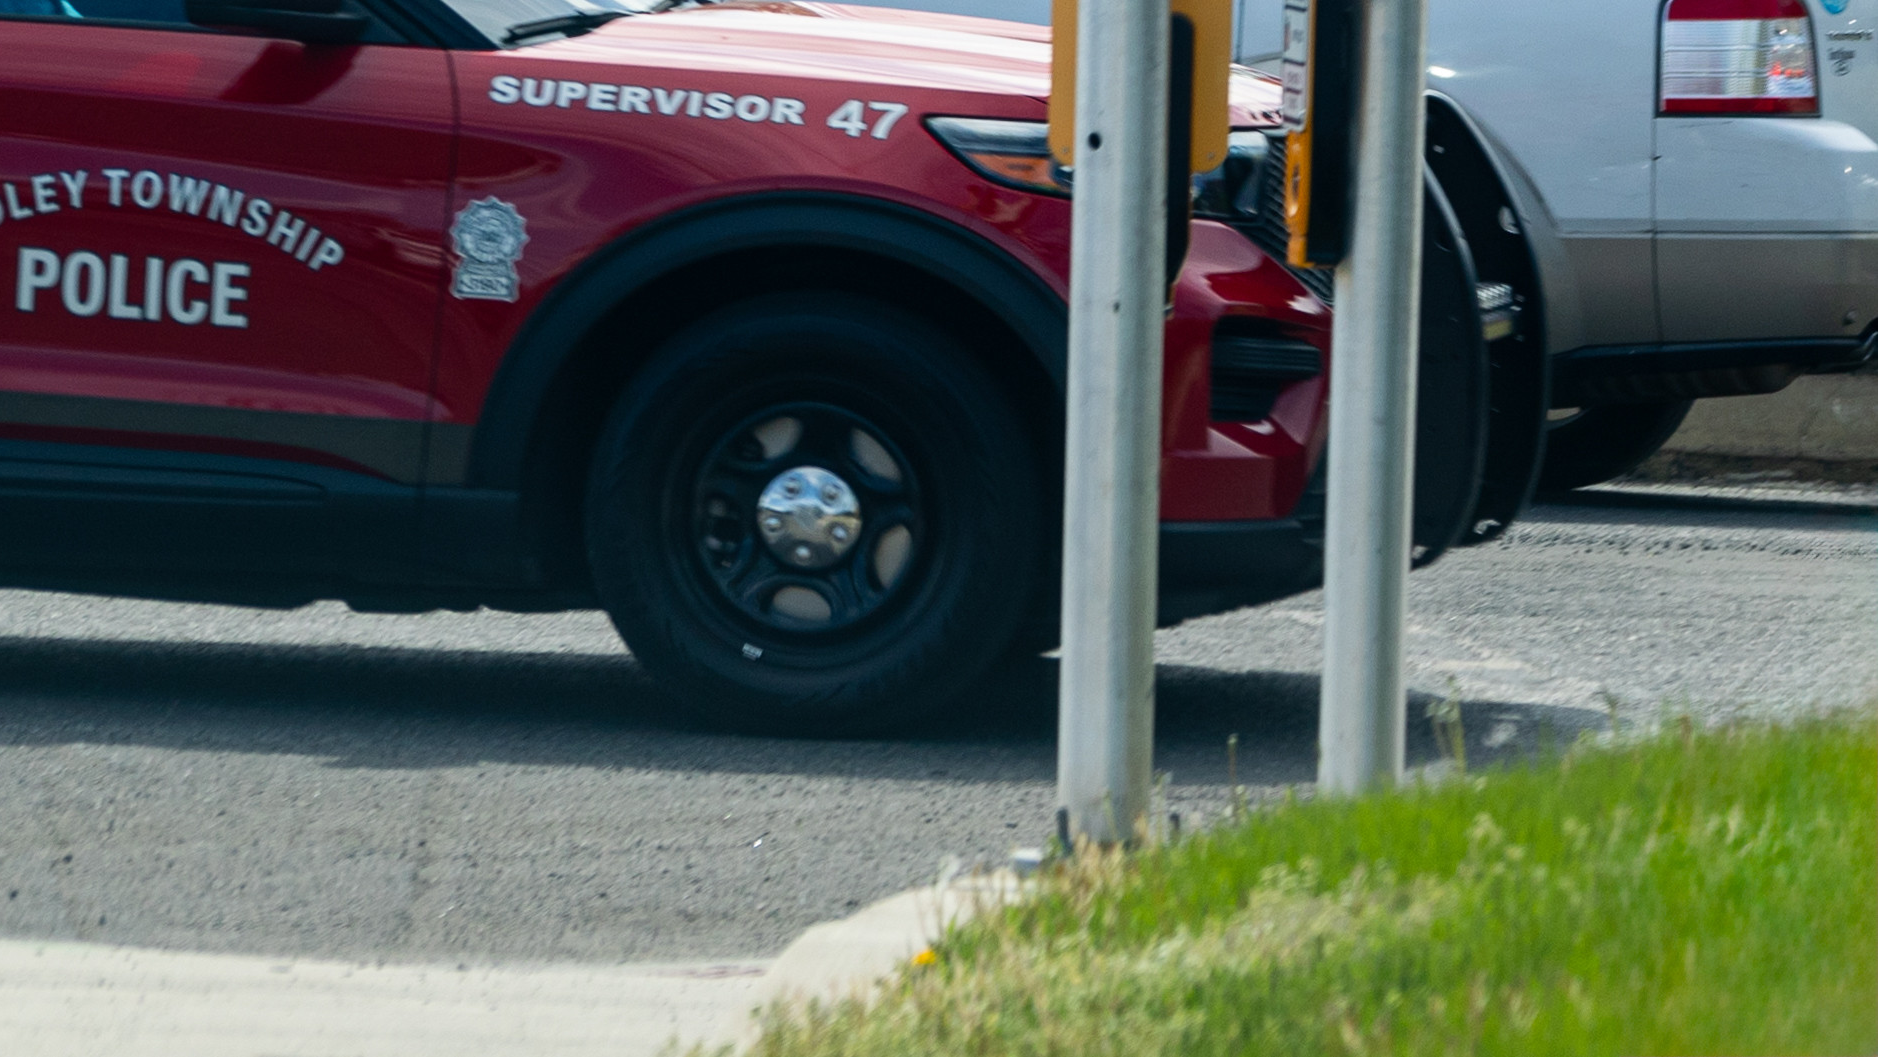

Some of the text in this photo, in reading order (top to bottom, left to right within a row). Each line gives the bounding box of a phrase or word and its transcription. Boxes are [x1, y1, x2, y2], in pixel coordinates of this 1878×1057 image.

[489, 75, 908, 140] SUPERVISOR 47
[102, 168, 345, 272] TOWNSHIP
[16, 246, 251, 328] POLICE
